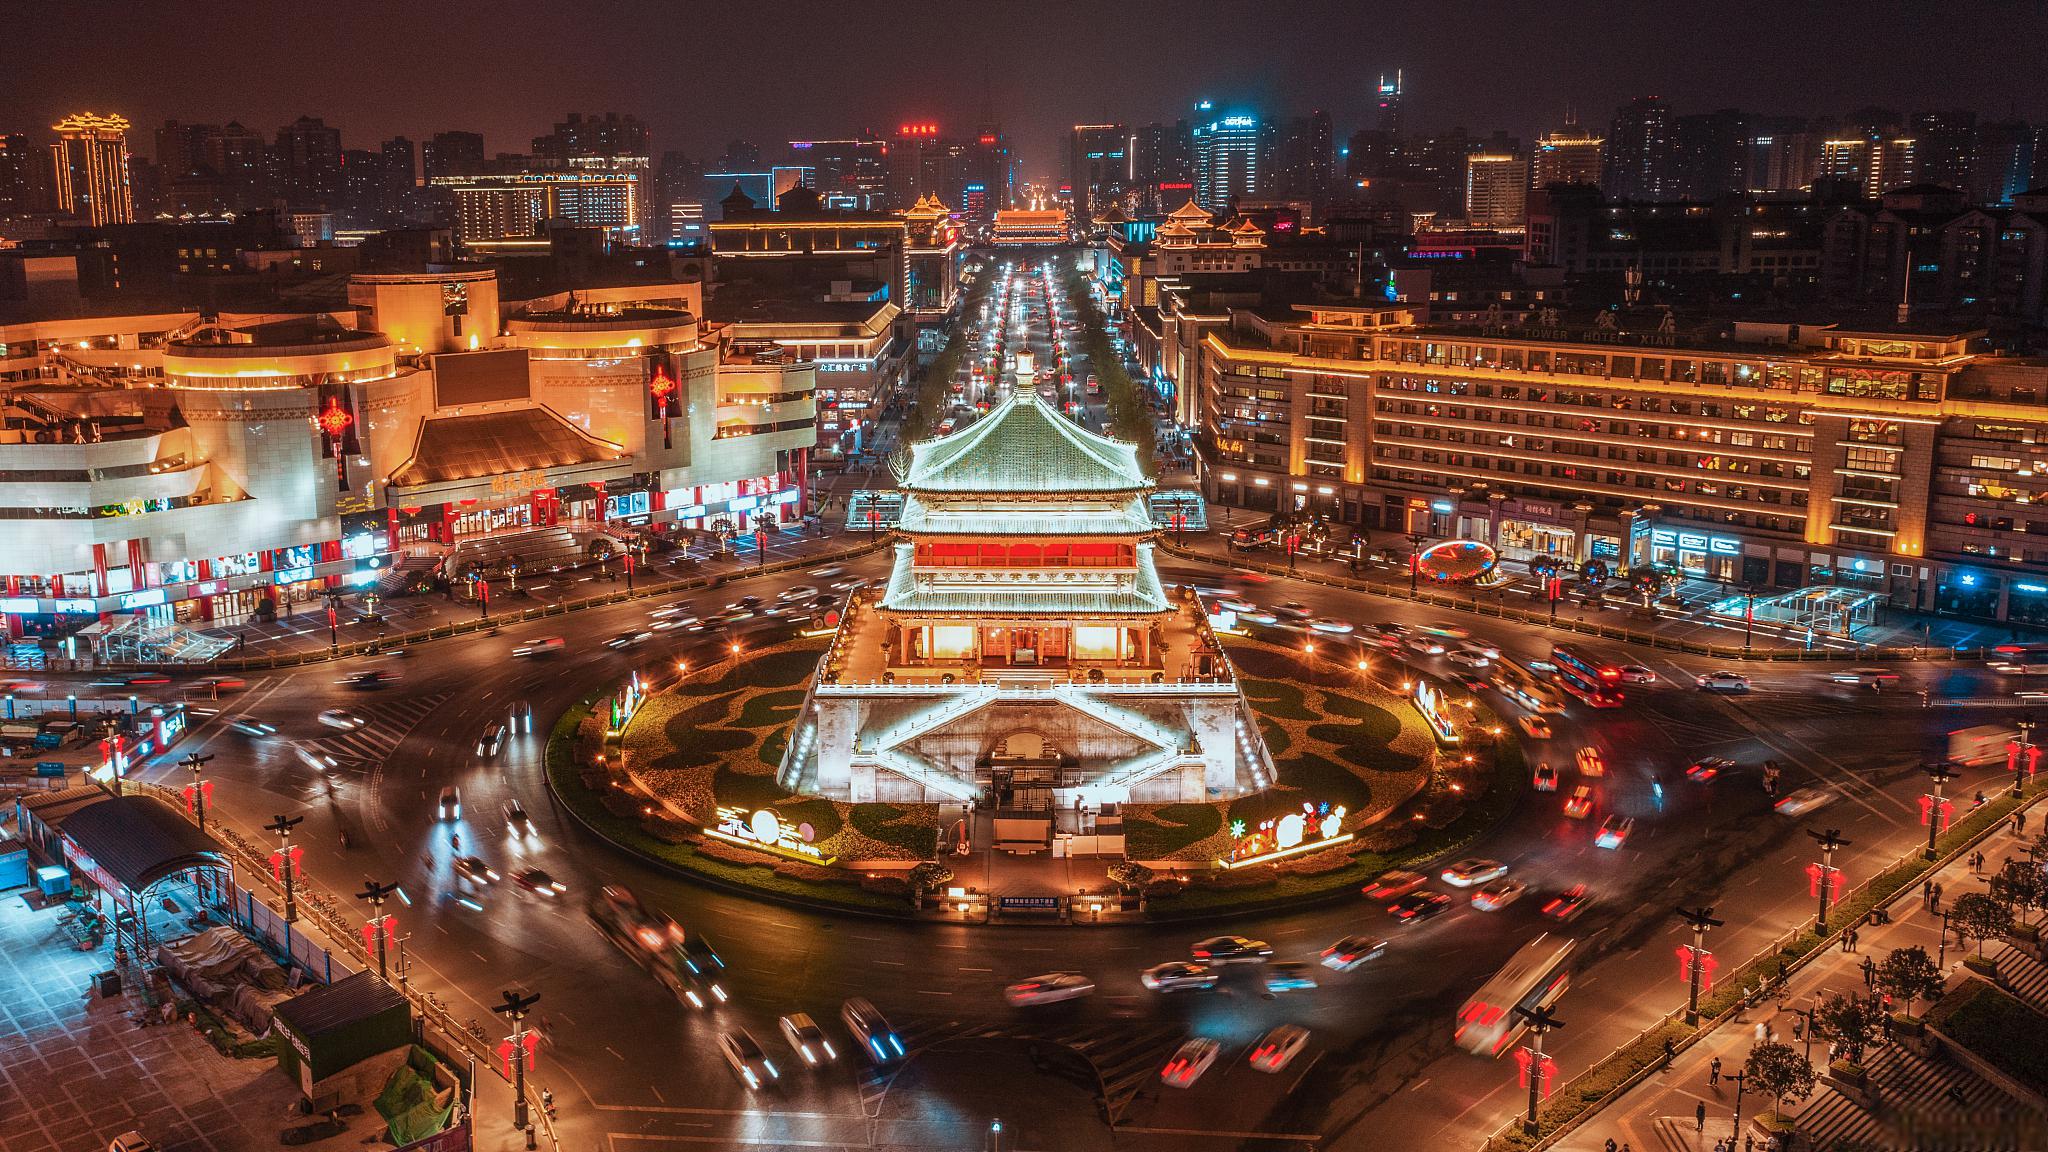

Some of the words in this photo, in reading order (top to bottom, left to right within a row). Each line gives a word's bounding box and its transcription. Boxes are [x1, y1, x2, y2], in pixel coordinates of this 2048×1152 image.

[1524, 328, 1568, 341] TOWER
[1583, 331, 1623, 344] HOTEL
[1640, 335, 1675, 346] XIAN
[819, 363, 867, 372] 众汇美食广场
